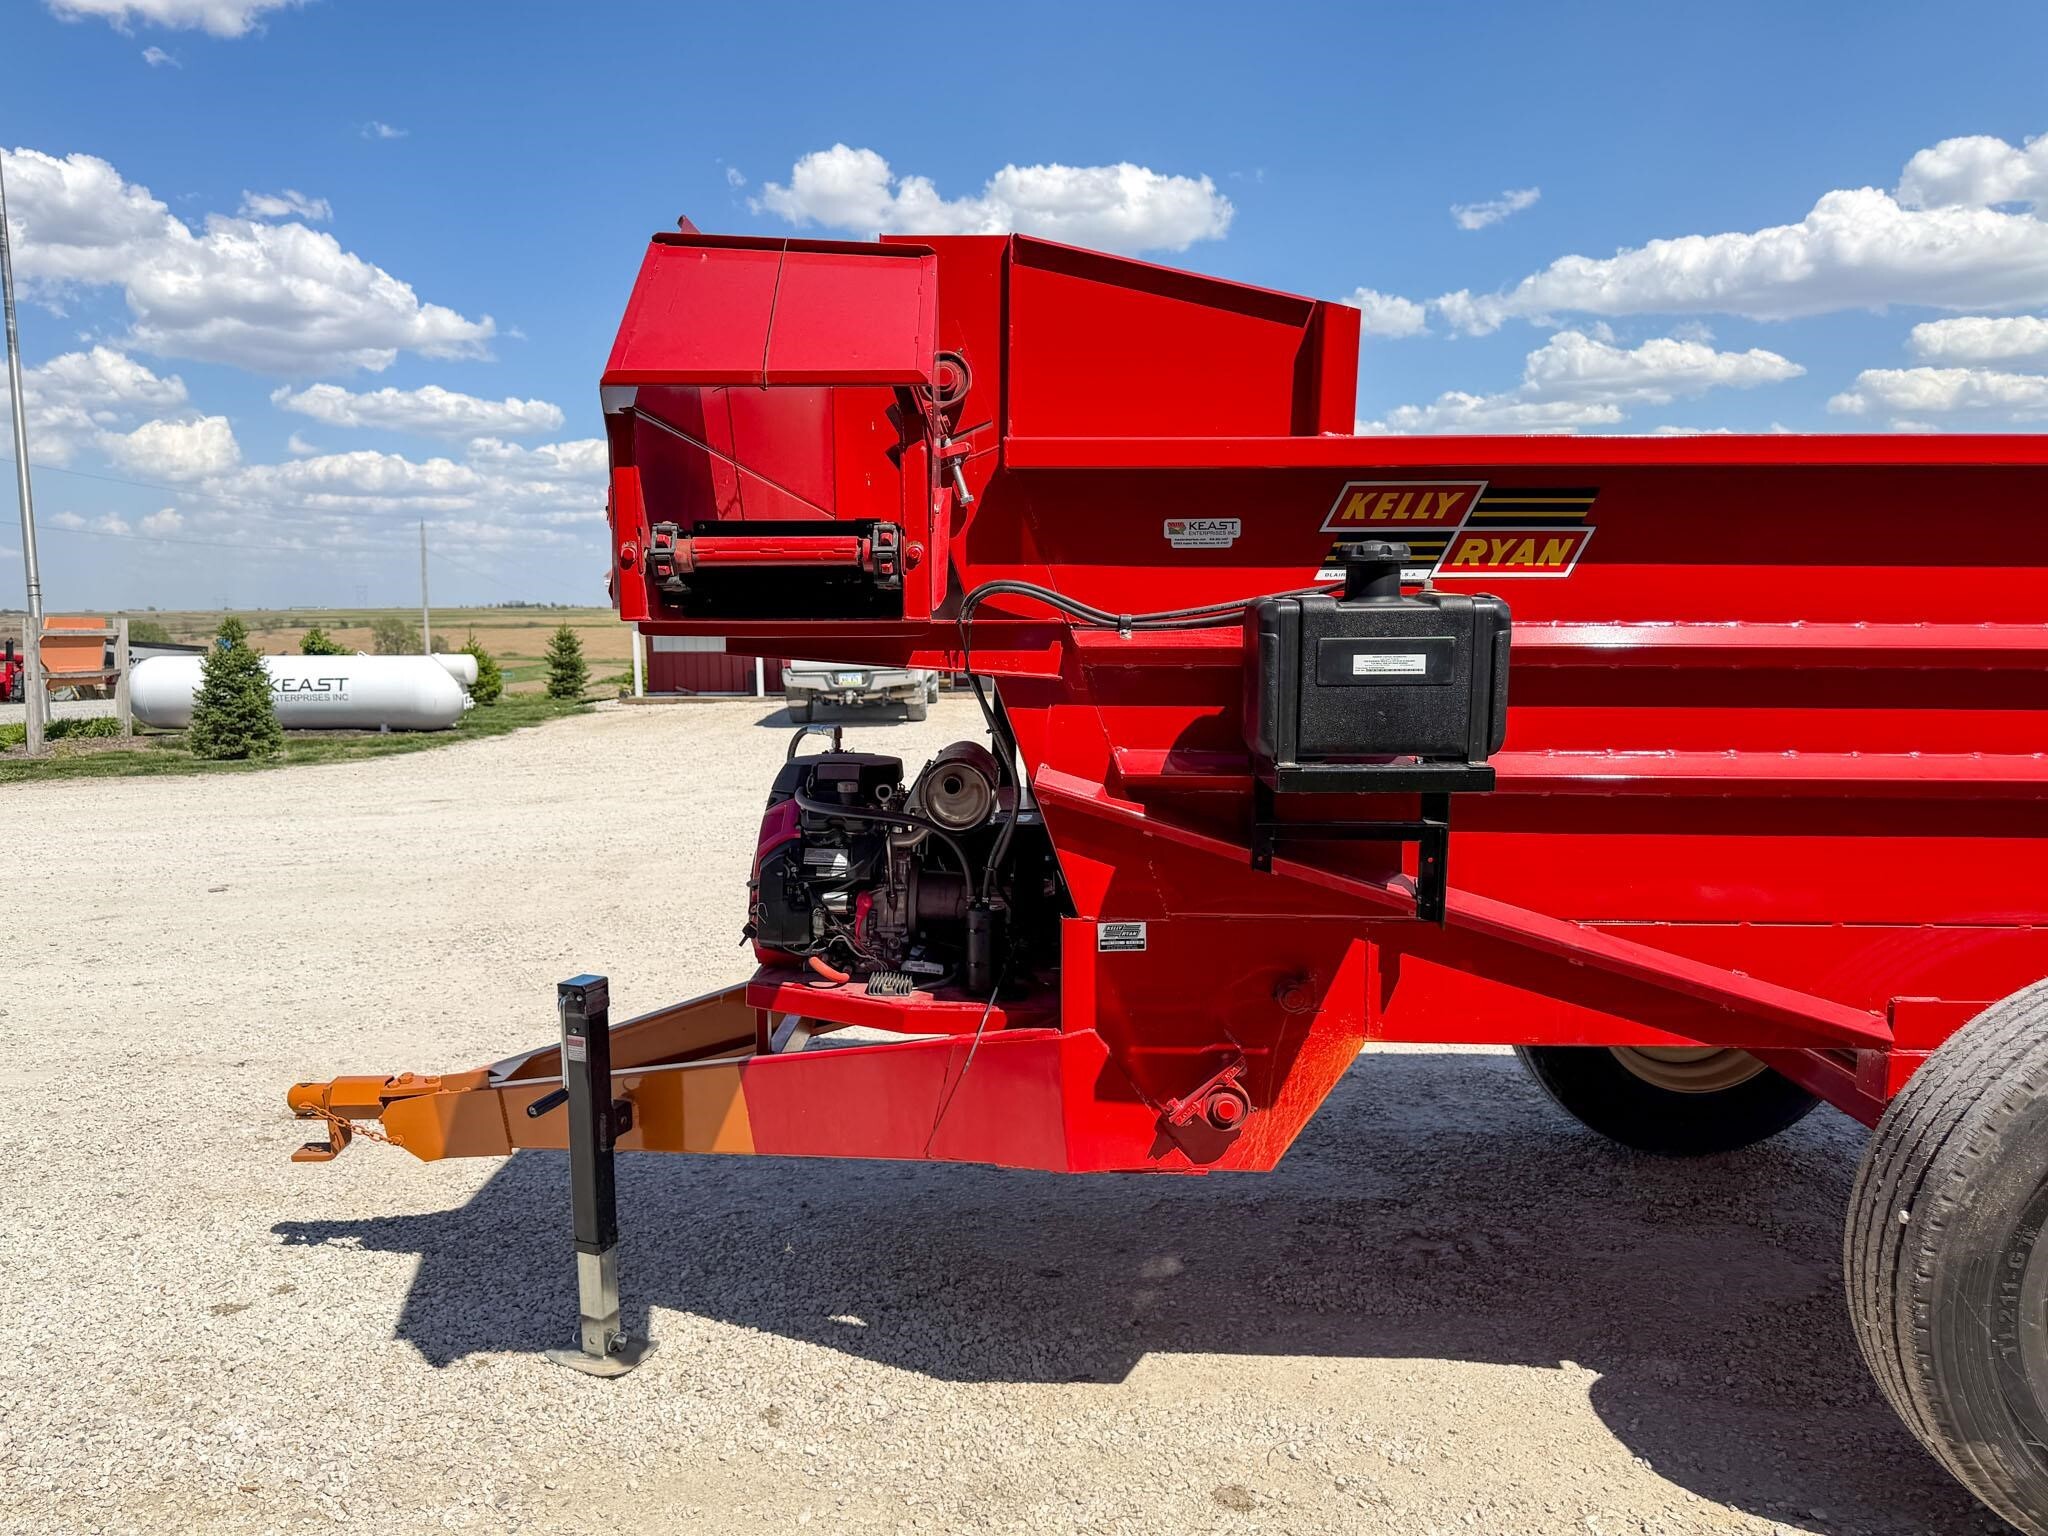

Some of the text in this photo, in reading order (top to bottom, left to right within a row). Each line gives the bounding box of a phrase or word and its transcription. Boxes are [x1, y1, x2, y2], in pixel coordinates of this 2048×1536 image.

[1341, 492, 1465, 520] KELLY
[1188, 521, 1237, 530] KEAST
[1451, 538, 1575, 566] RYAN
[267, 677, 349, 692] KEAST
[268, 693, 349, 702] NTERPRISES INC
